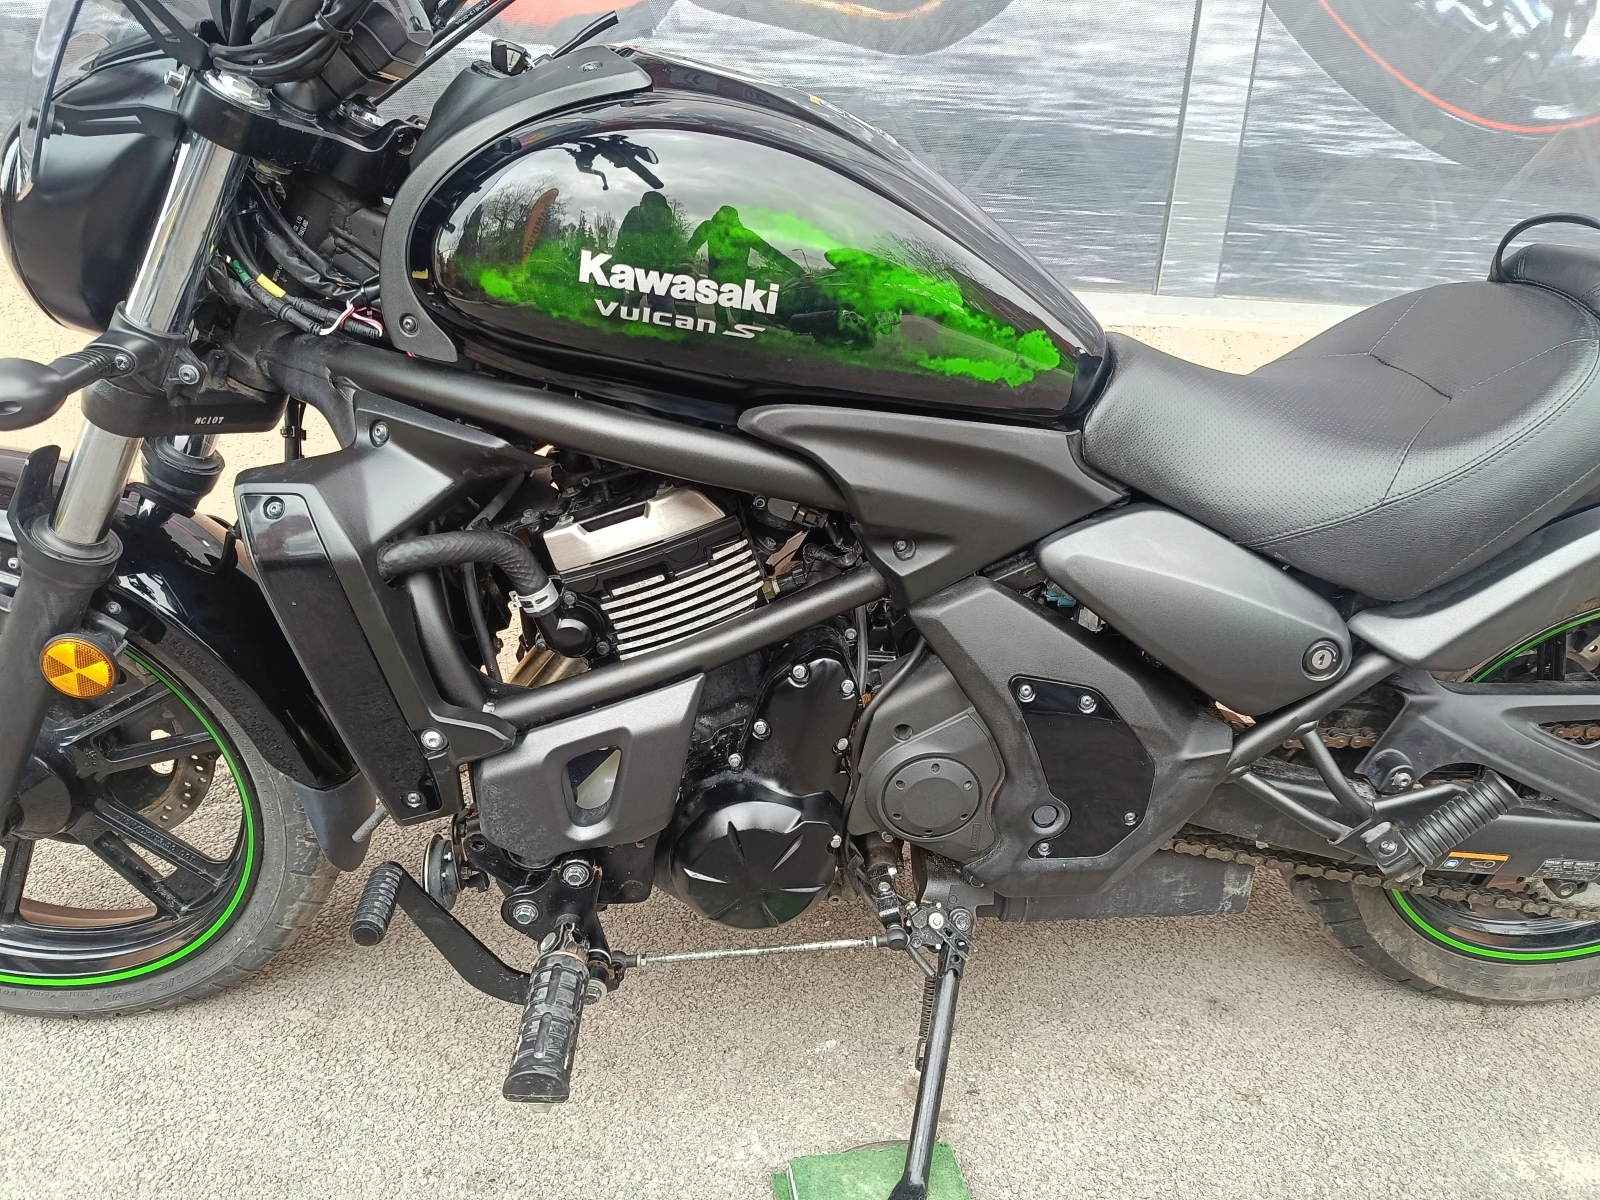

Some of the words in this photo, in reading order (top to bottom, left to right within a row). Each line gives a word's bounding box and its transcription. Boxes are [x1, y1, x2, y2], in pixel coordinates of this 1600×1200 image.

[578, 250, 780, 315] Kawasaki
[594, 298, 717, 334] Vulcan
[721, 323, 766, 339] S
[194, 416, 225, 425] MC107
